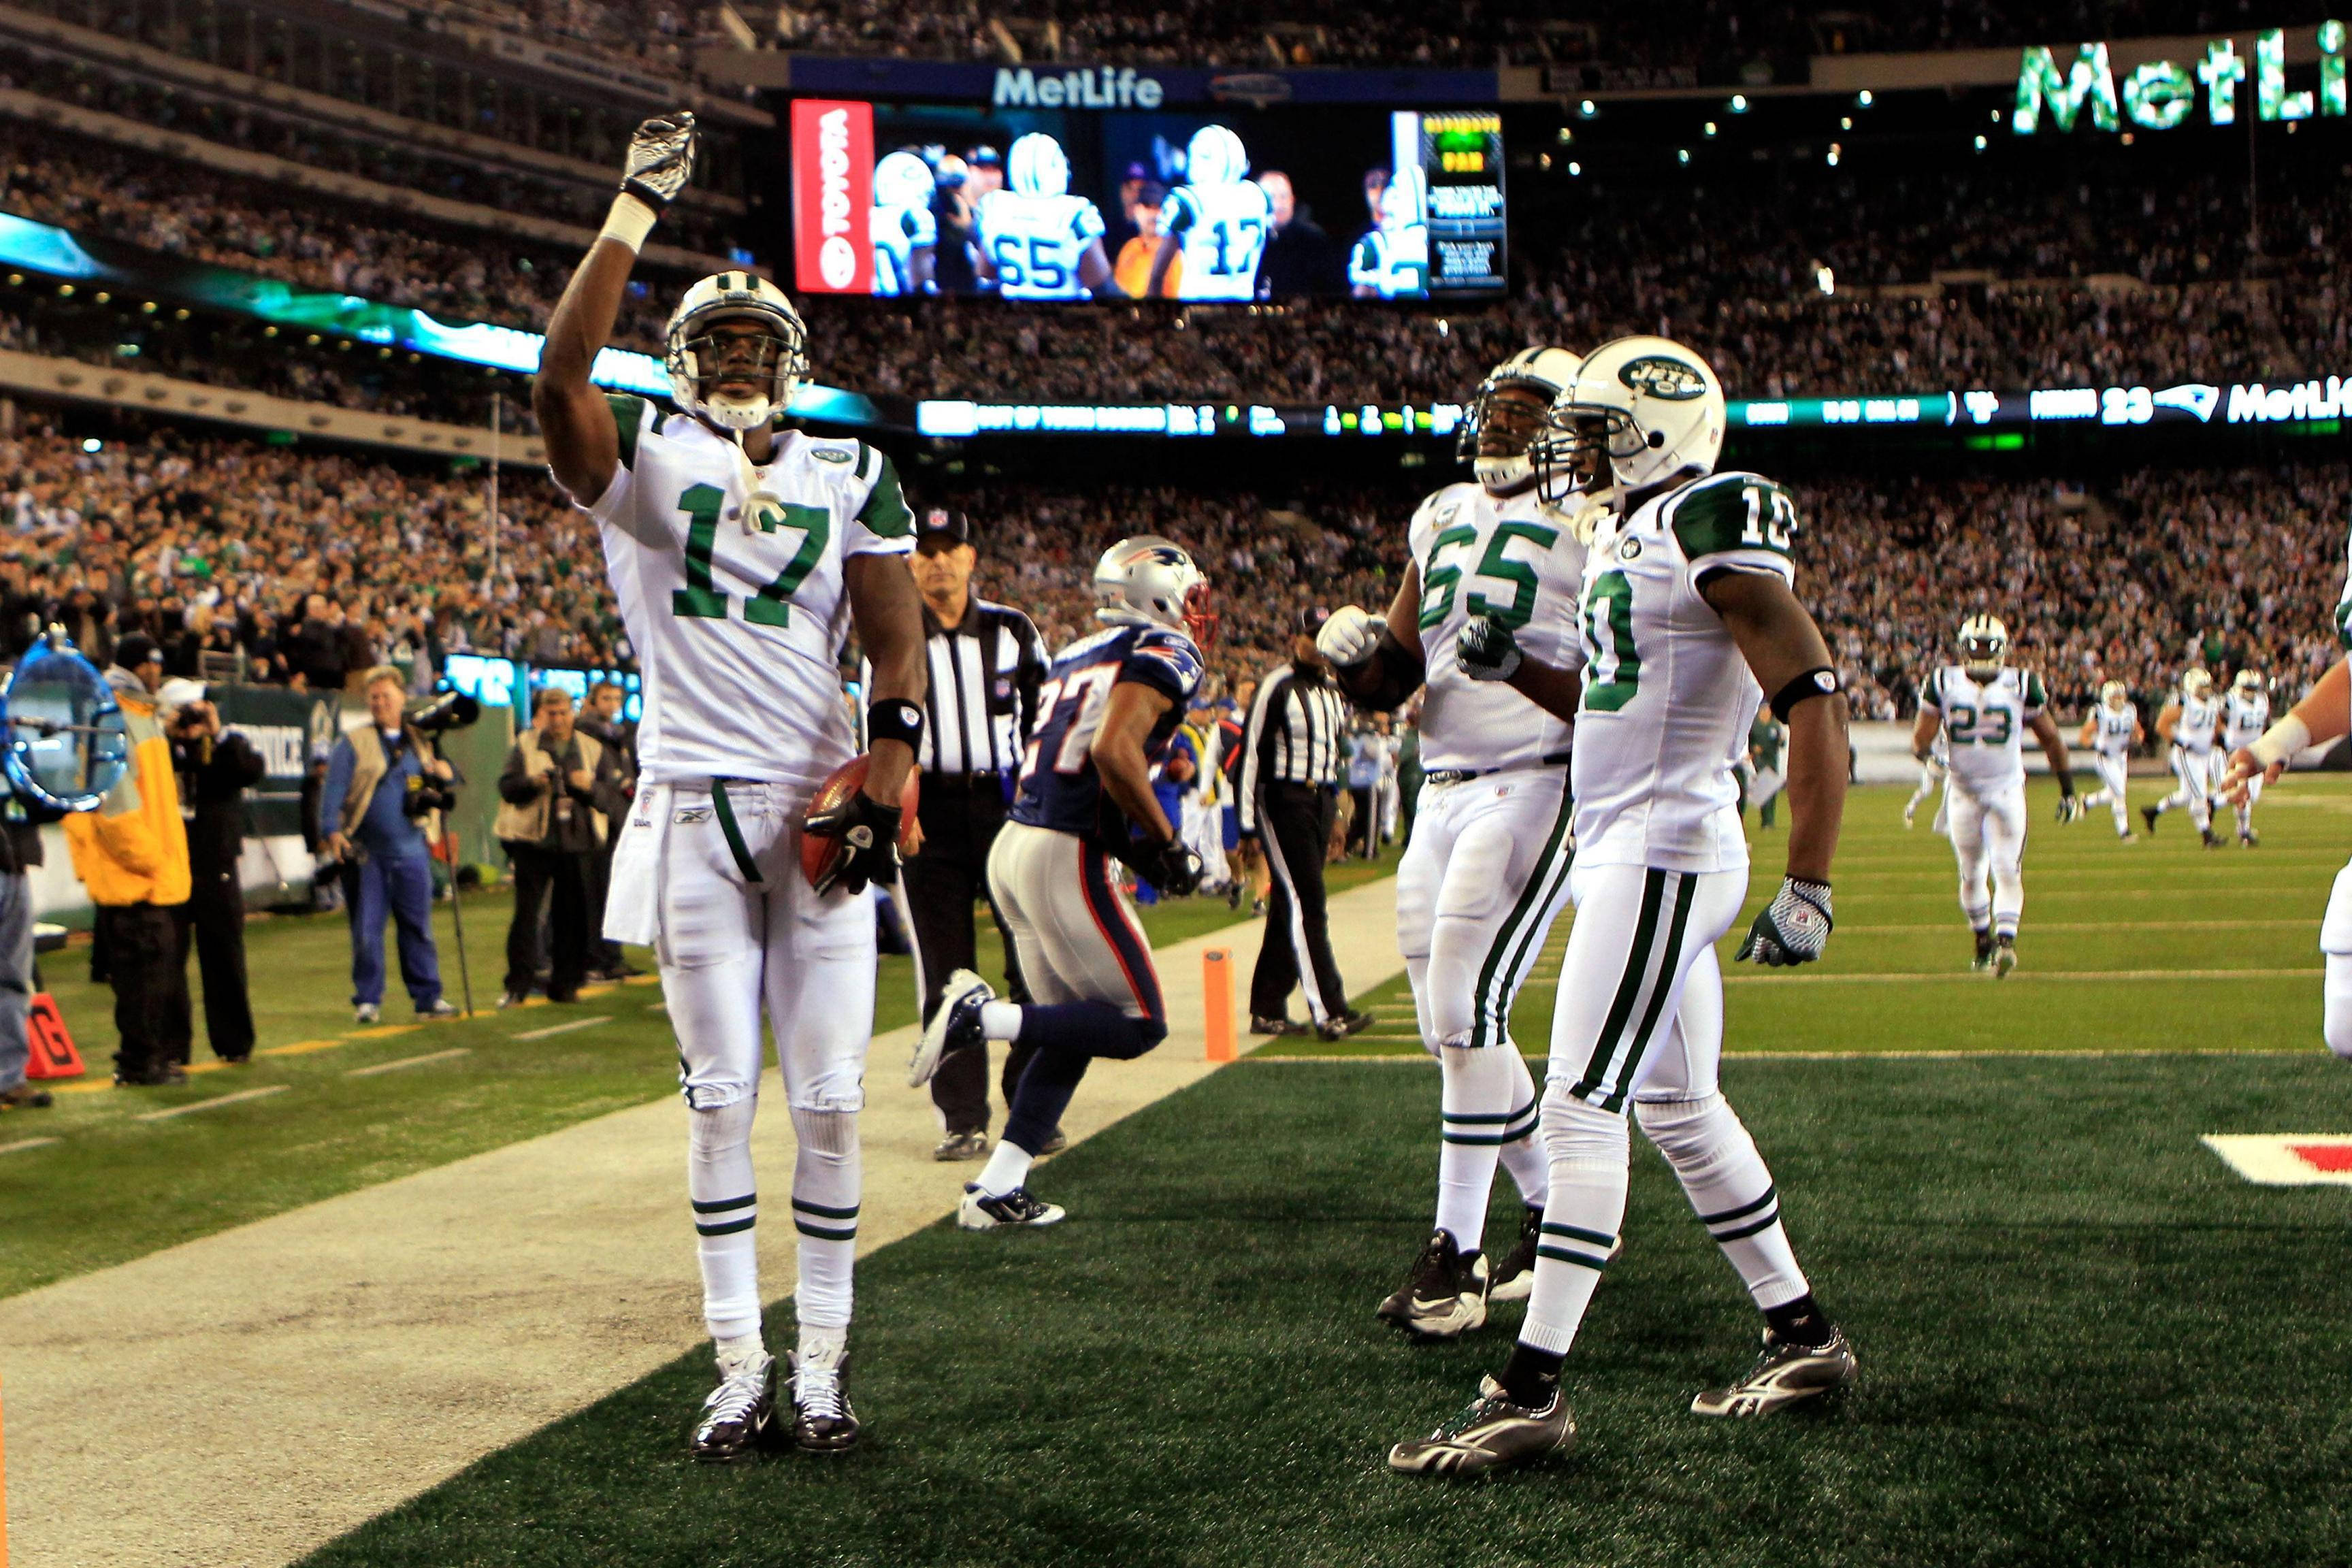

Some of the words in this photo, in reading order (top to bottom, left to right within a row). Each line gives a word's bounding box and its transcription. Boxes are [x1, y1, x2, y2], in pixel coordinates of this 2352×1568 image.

[994, 65, 1163, 108] MetLife
[994, 233, 1066, 288] 65
[1210, 218, 1261, 275] 17
[2102, 386, 2153, 425] 23
[672, 483, 830, 628] 17
[1419, 523, 1560, 631] 65
[1575, 570, 1641, 713] 0
[1950, 704, 2012, 744] 23
[31, 1005, 74, 1066] G
